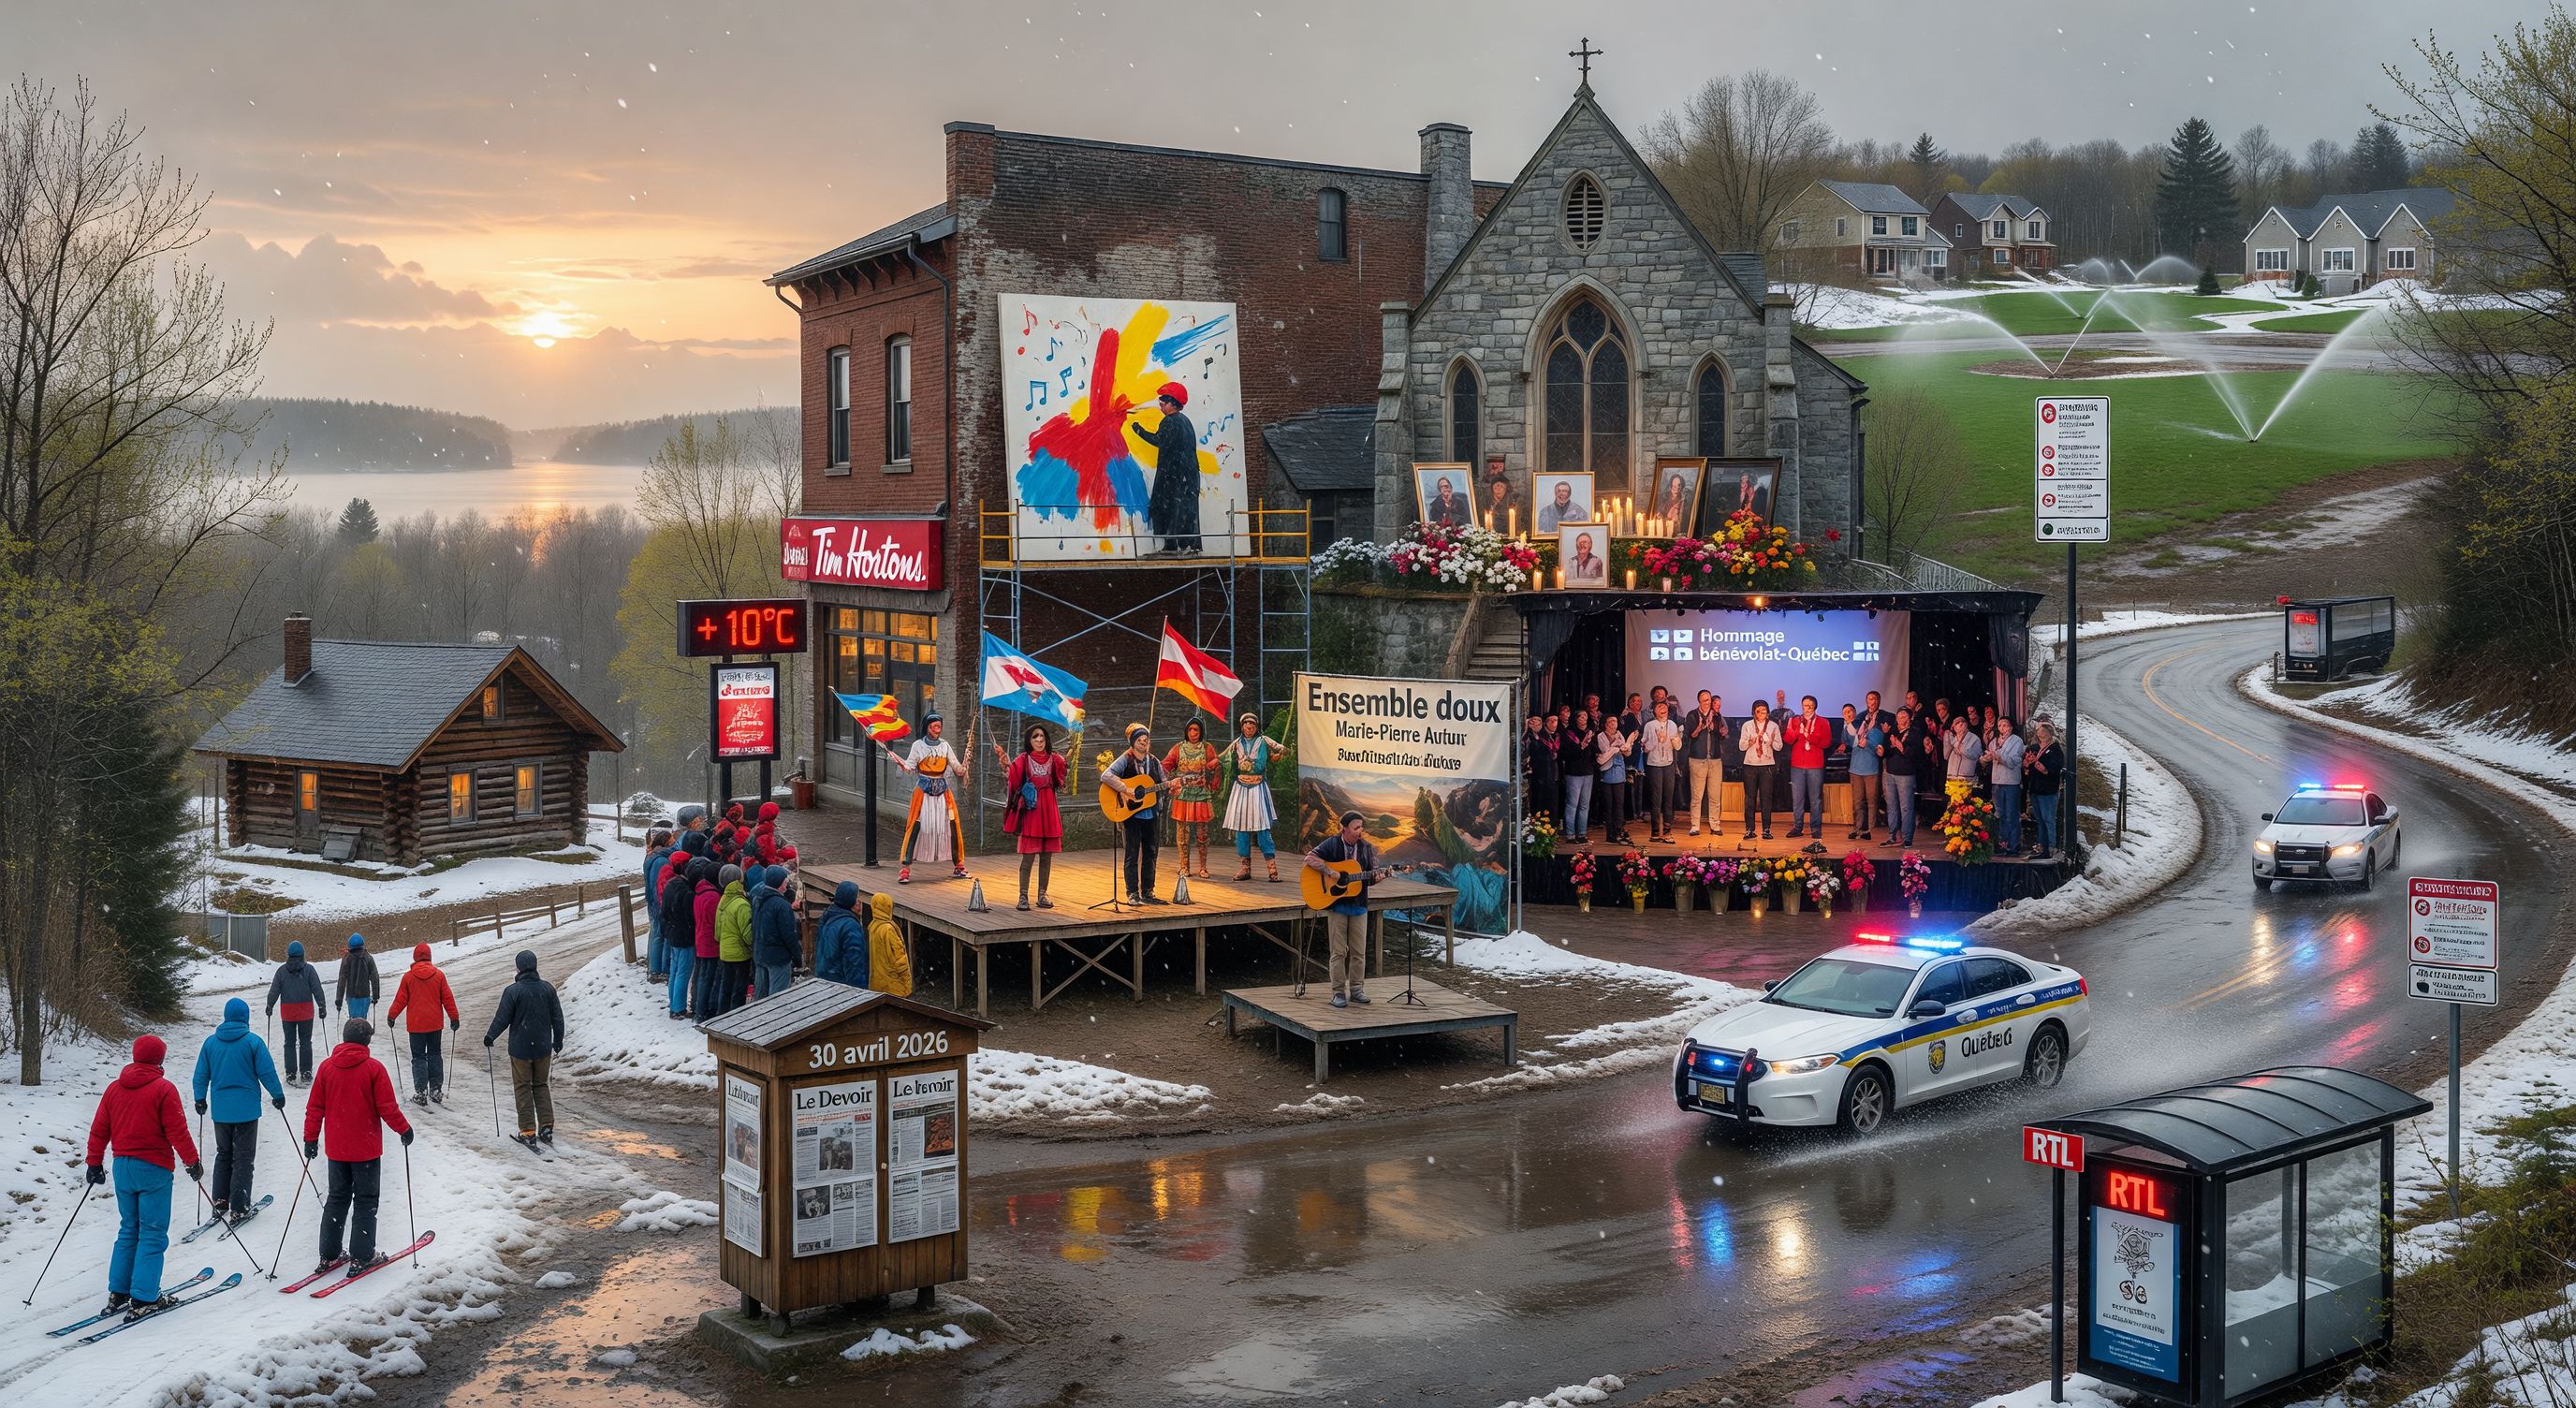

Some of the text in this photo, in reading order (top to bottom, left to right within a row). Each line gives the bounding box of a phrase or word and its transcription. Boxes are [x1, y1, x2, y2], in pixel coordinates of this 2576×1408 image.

[812, 526, 843, 577] Tim
[1700, 628, 1785, 646] Hommage
[1700, 646, 1850, 662] bénévolat-Québec
[1308, 682, 1501, 723] Ensemble doux
[1336, 720, 1420, 742] Marie-Pierre
[809, 1031, 949, 1069] 30 avril 2026
[796, 1087, 872, 1109] Le Devoir
[893, 1081, 913, 1097] Le
[2032, 1132, 2074, 1167] RTL
[2110, 1171, 2165, 1217] RTL
